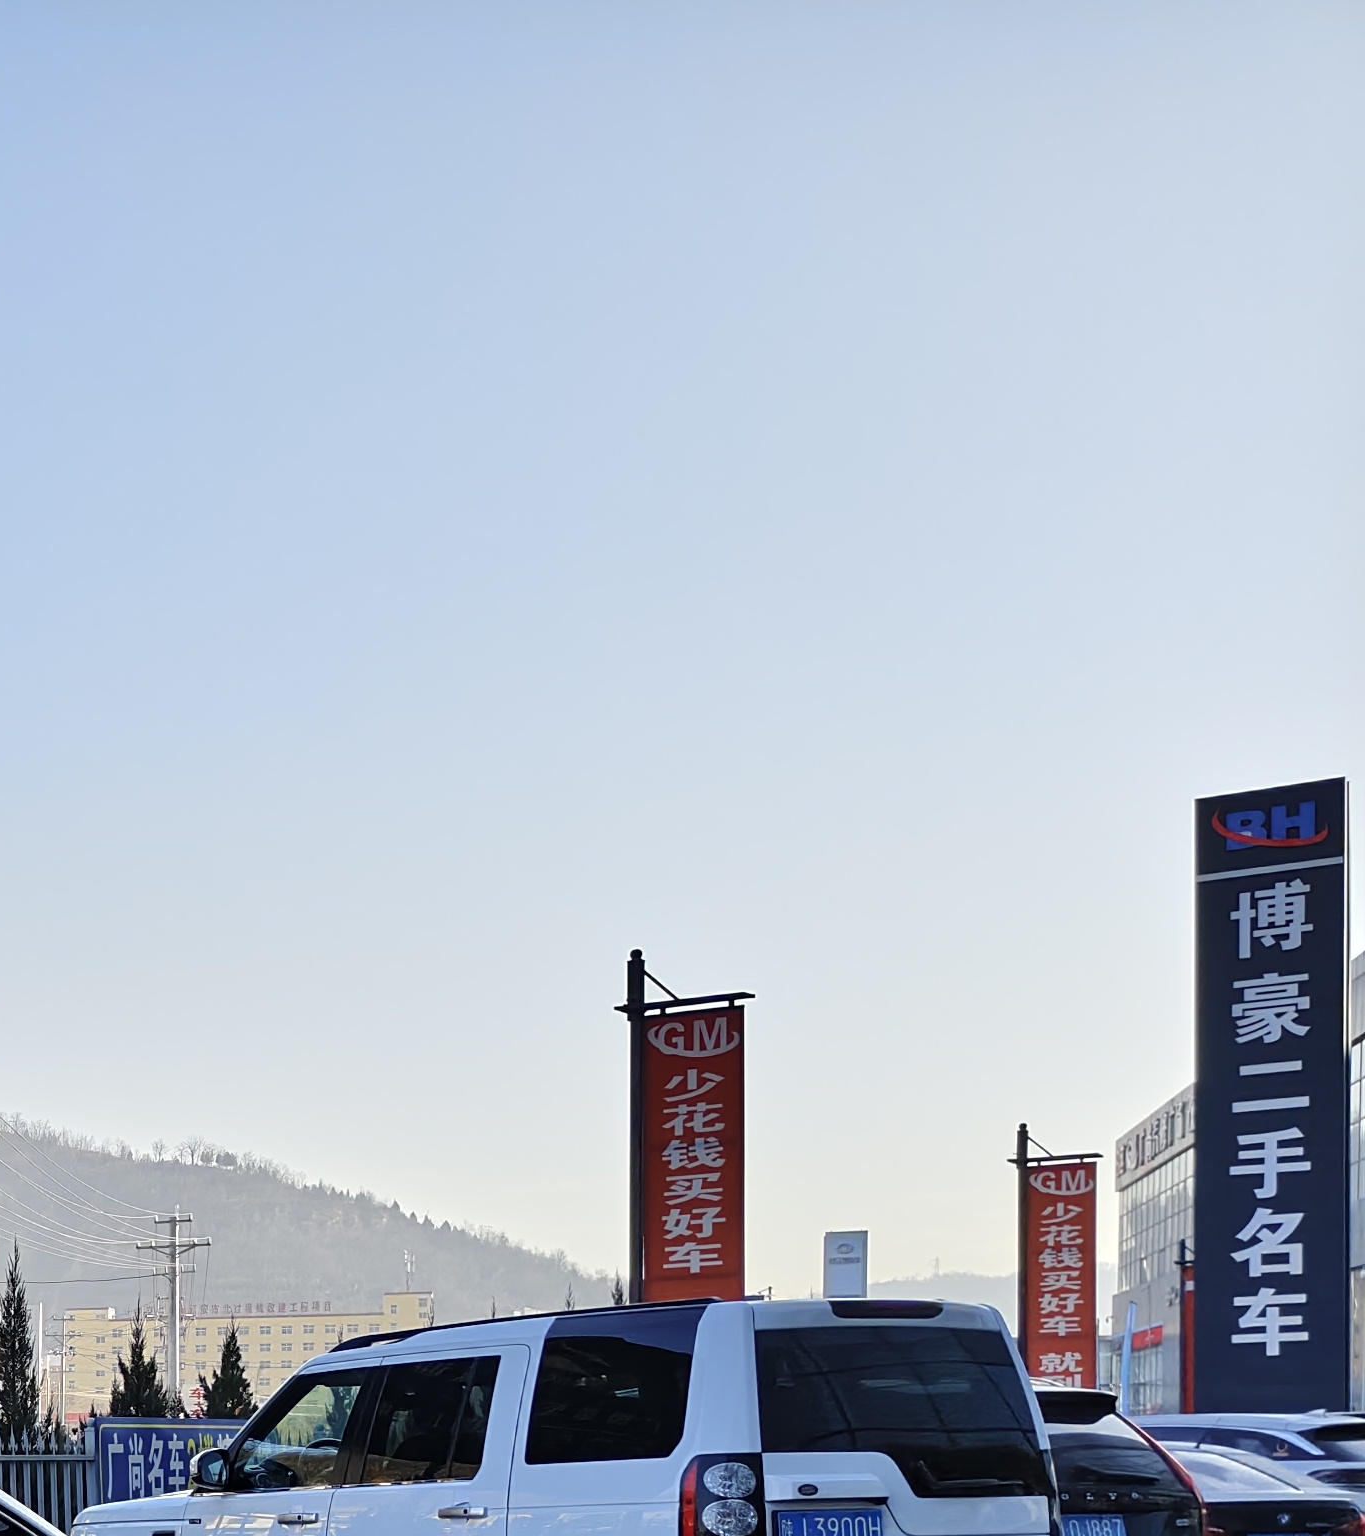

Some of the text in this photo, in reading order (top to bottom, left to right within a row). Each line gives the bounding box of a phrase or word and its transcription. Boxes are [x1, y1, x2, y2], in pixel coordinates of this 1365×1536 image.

[1225, 800, 1316, 851] BH
[657, 1016, 729, 1057] GM
[1229, 879, 1314, 1356] 博豪二手名车
[661, 1068, 726, 1274] 少花钱买好车
[1037, 1168, 1087, 1194] GM
[1038, 1202, 1084, 1337] 少花钱买好车
